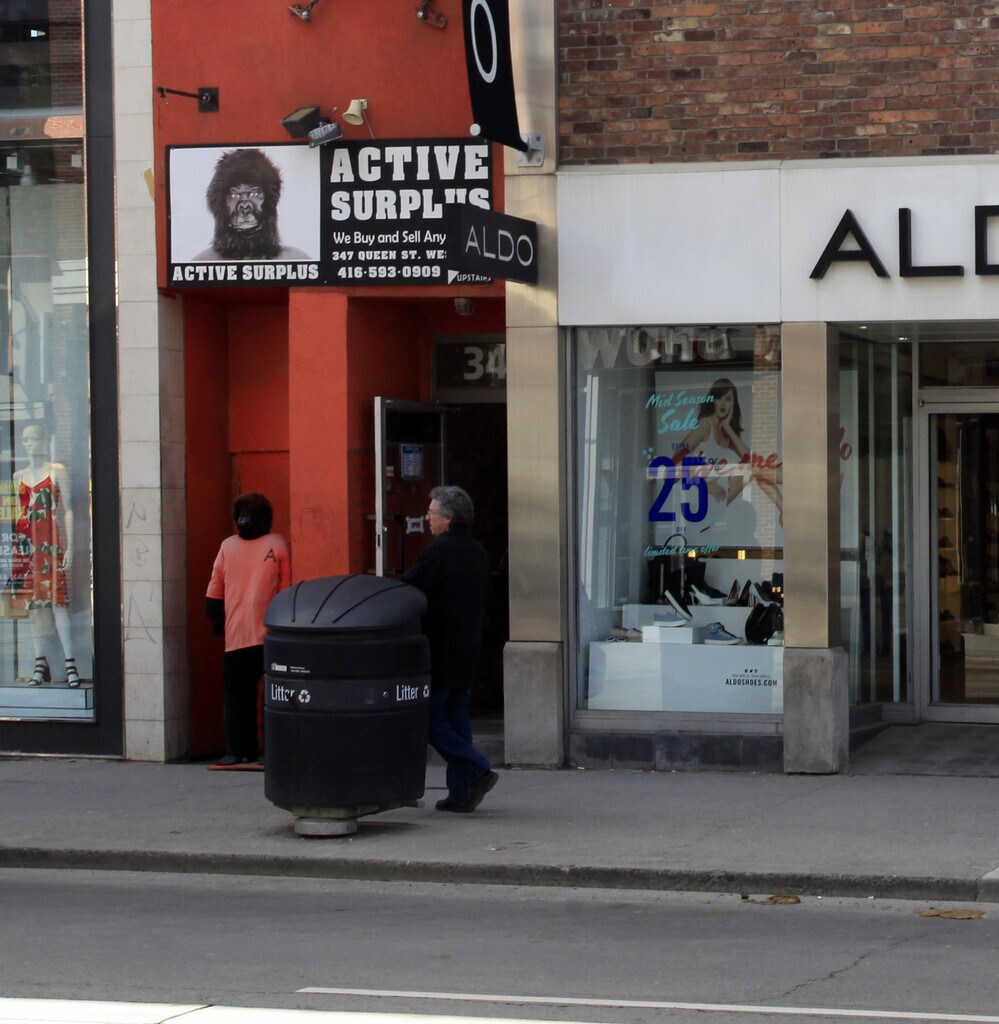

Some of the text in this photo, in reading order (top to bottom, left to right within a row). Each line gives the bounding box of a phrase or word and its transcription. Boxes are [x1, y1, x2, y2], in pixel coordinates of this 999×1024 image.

[330, 144, 489, 183] ACTIVE
[333, 231, 351, 244] We
[354, 231, 375, 246] Buy
[377, 230, 399, 243] and
[402, 230, 421, 243] Sell
[464, 223, 534, 268] ALDO
[332, 249, 447, 261] 347 QUEEN ST. WE
[172, 264, 319, 281] ACTIVE SURPLUS
[645, 390, 716, 410] Mid Season
[657, 409, 700, 436] Sale
[263, 548, 277, 563] A
[725, 678, 778, 687] ALDOSHOES.COM
[396, 684, 419, 702] Litter
